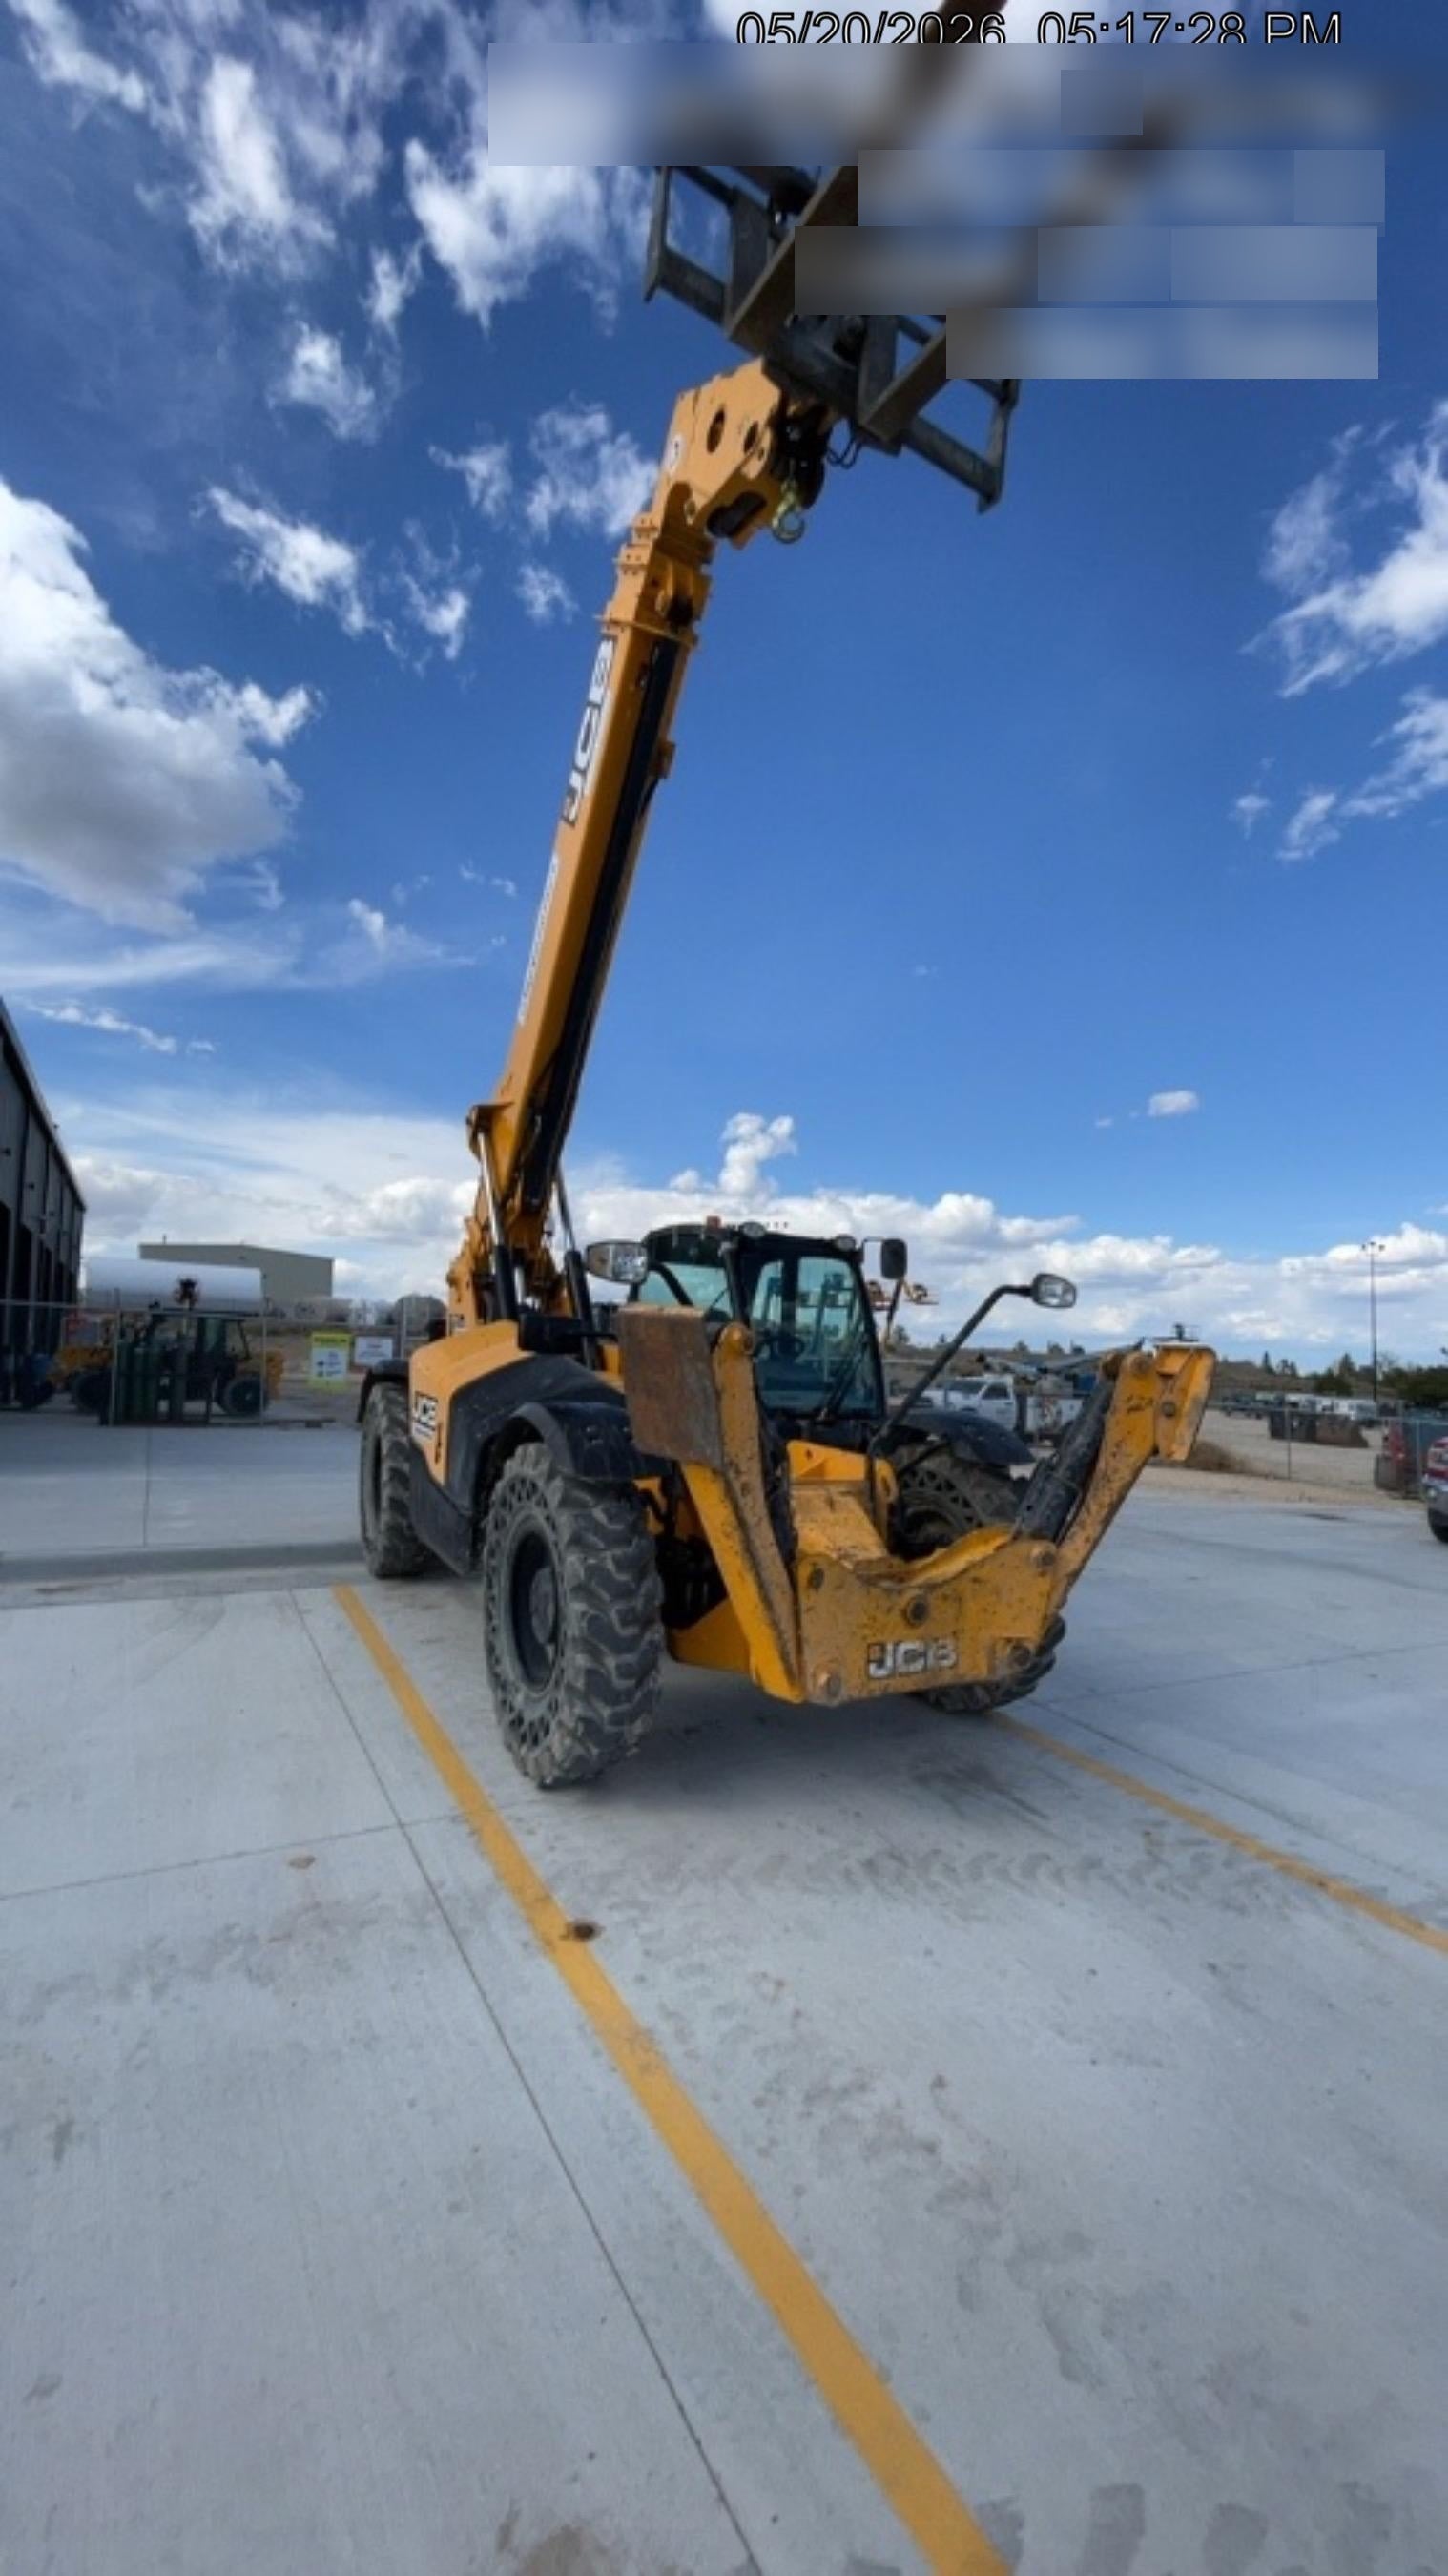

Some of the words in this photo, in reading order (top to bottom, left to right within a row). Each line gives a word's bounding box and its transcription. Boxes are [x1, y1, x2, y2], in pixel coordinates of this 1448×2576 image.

[562, 638, 615, 823] JCB
[412, 1395, 437, 1429] JCB
[867, 1638, 957, 1678] JCB
